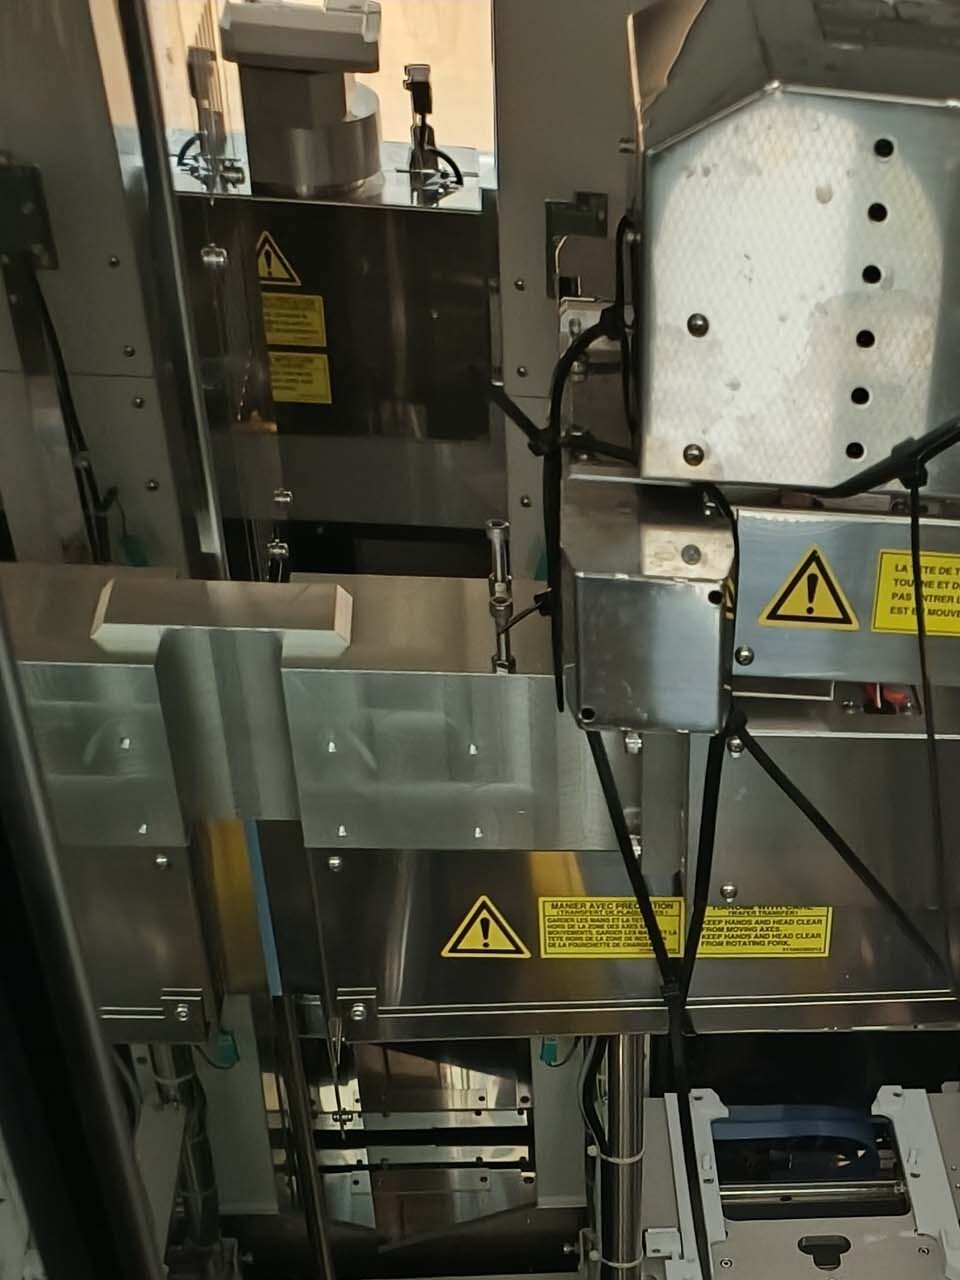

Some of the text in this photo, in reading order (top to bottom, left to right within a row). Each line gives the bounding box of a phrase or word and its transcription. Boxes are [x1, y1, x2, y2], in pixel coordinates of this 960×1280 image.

[895, 563, 908, 573] LA
[938, 566, 953, 576] DE
[893, 578, 934, 589] TOUNE
[936, 580, 949, 589] ET
[891, 592, 912, 602] PAS
[889, 606, 909, 616] EST
[589, 902, 614, 910] AVEC
